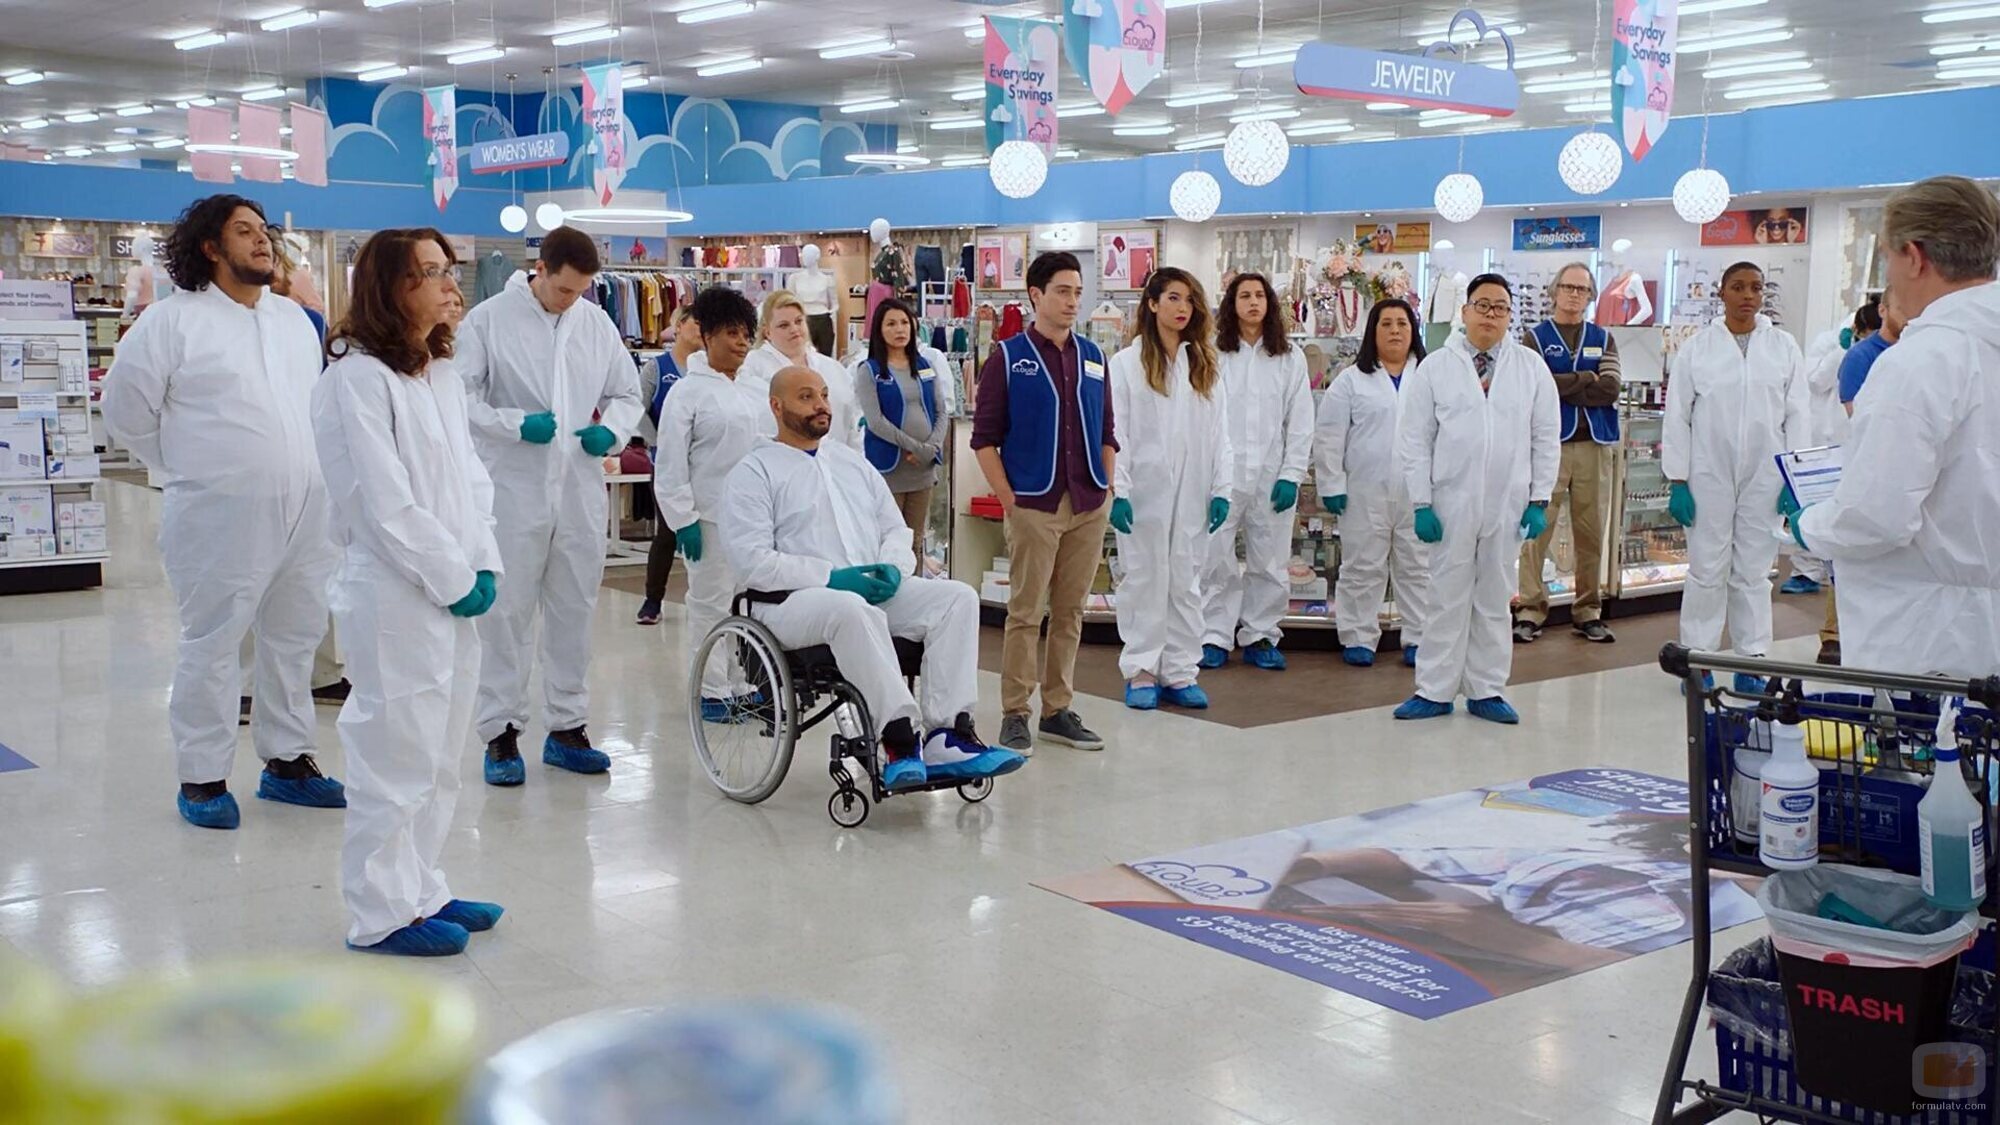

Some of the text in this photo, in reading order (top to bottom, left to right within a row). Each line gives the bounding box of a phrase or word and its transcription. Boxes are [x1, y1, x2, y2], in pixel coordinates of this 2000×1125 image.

[1616, 18, 1666, 46] Everyday
[1631, 42, 1671, 68] Savings
[989, 63, 1045, 87] Everyday
[1371, 59, 1456, 97] JEWELRY
[1008, 83, 1053, 105] Savings
[481, 138, 556, 163] WOMEN'S WEAR
[116, 240, 168, 255] SHES
[1529, 231, 1586, 245] Sunglasses
[1212, 915, 1450, 992] Debit or Credit card for
[1269, 922, 1432, 974] Cloud9 Rewards
[1352, 937, 1410, 954] your
[1208, 926, 1295, 954] shipping
[1293, 953, 1325, 964] on
[1323, 962, 1360, 974] all
[1354, 973, 1441, 1002] orders!
[1796, 984, 1905, 1025] TRASH
